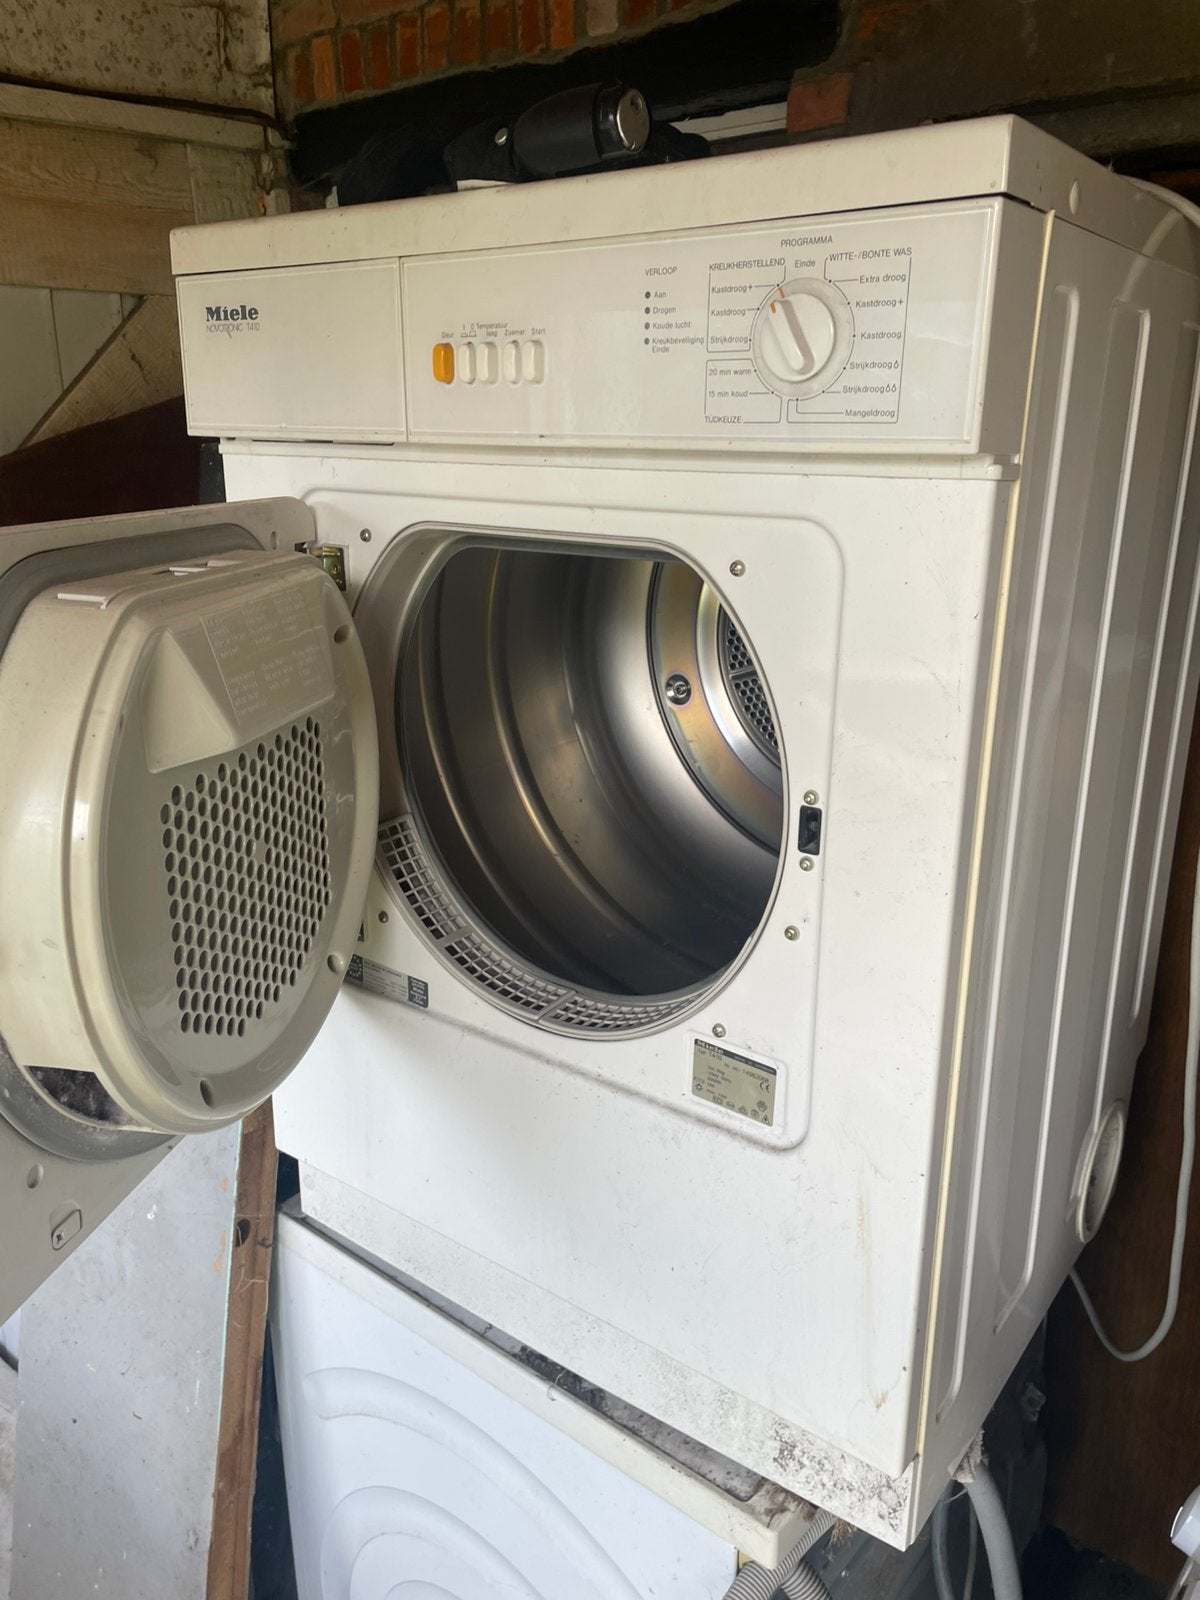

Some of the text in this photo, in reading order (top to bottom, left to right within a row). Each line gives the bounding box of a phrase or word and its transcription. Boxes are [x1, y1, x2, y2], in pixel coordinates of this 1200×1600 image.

[780, 236, 833, 248] PROGRAMMA
[893, 247, 913, 257] WAS
[709, 258, 786, 271] KREUKHERSTELLEND
[794, 260, 816, 268] Einde
[645, 266, 678, 276] VERLOOP
[859, 273, 907, 284] Extra droog
[653, 290, 667, 298] Aan
[205, 304, 259, 321] Miele
[652, 306, 677, 316] Drogen
[711, 308, 746, 317] Kastdroog
[206, 323, 243, 336] NOVOTRONIC
[652, 320, 691, 330] Koude lucht
[710, 335, 749, 345] Strijkdroog
[860, 330, 902, 341] Kastdroog
[652, 345, 670, 353] Einde
[849, 360, 893, 370] Strijkdroog
[708, 368, 718, 376] 20
[708, 390, 716, 398] 15
[730, 390, 749, 398] koud
[842, 385, 884, 394] Strijkdroog
[845, 408, 895, 418] Mangeldroog
